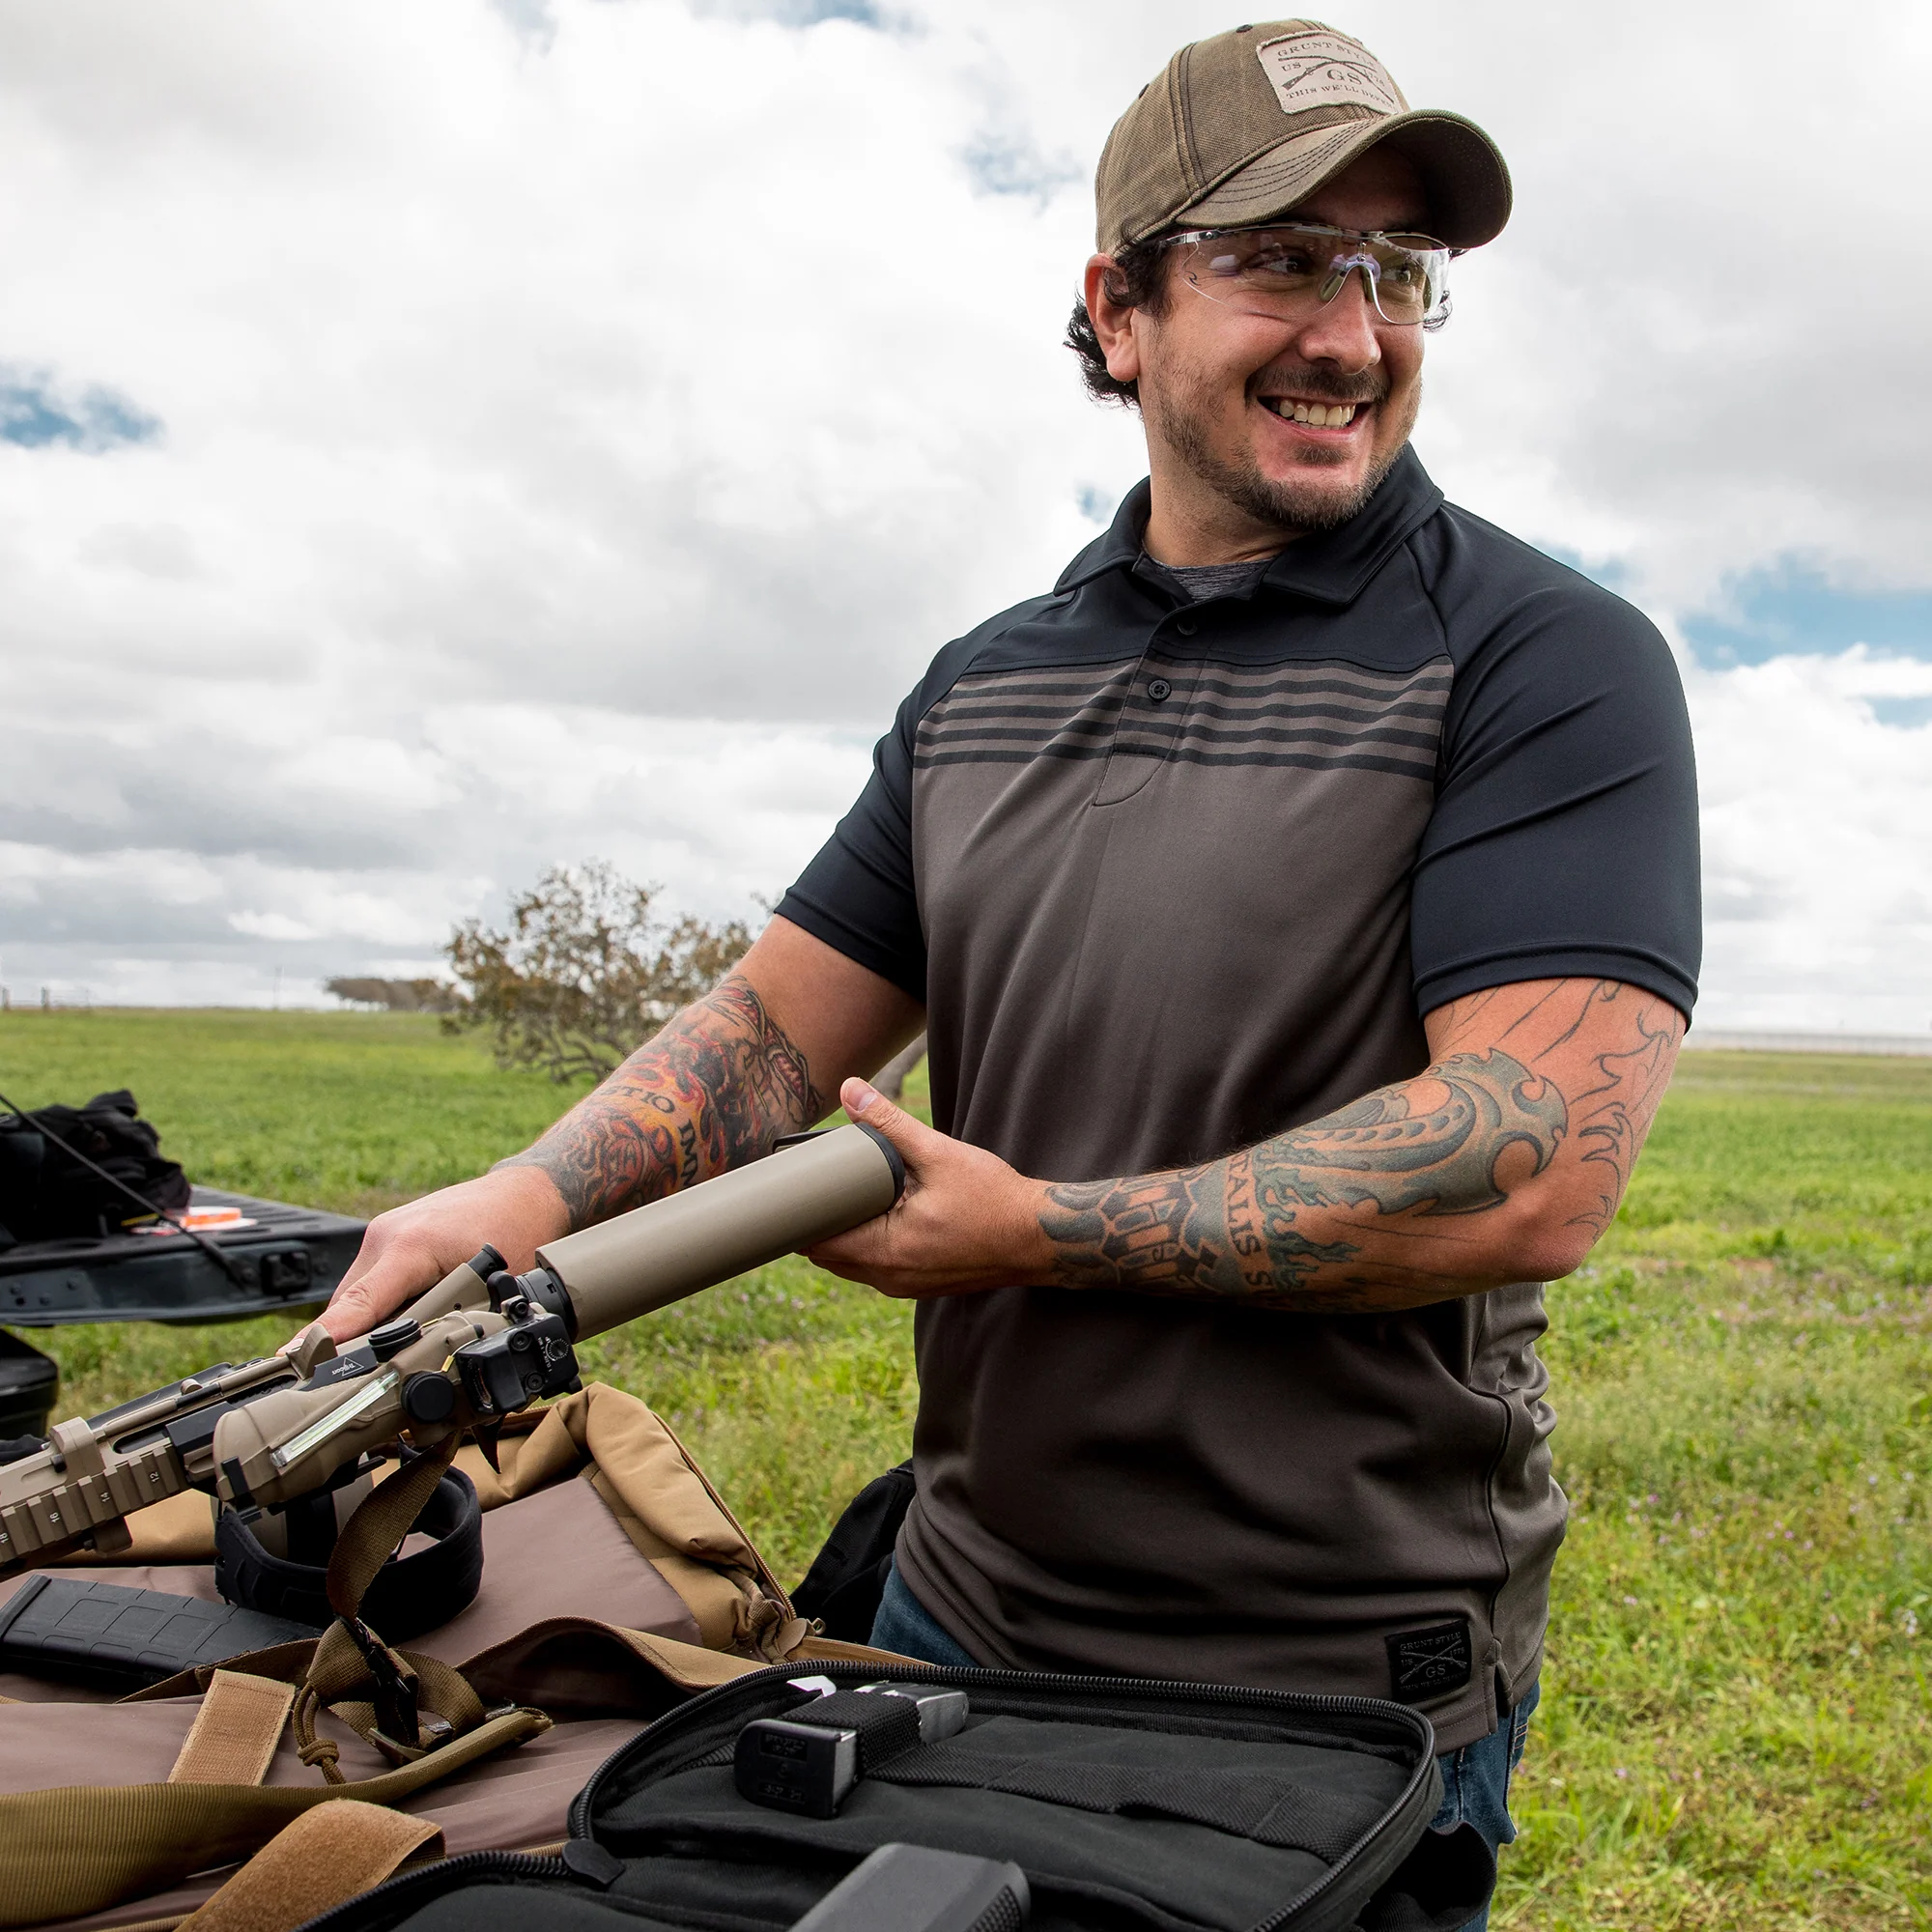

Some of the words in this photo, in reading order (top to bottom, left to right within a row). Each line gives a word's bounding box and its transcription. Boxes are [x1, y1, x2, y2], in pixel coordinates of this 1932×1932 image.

[1277, 42, 1332, 56] GRUNT
[1281, 62, 1302, 72] US
[1326, 69, 1362, 86] GS
[1286, 88, 1318, 99] THIS
[150, 1471, 159, 1483] 12
[101, 1492, 111, 1503] 14
[49, 1512, 60, 1523] 16
[0, 1532, 10, 1544] 18
[1400, 1639, 1434, 1652] GRUNT
[1435, 1632, 1461, 1644] STYLE
[1426, 1663, 1446, 1679] GS
